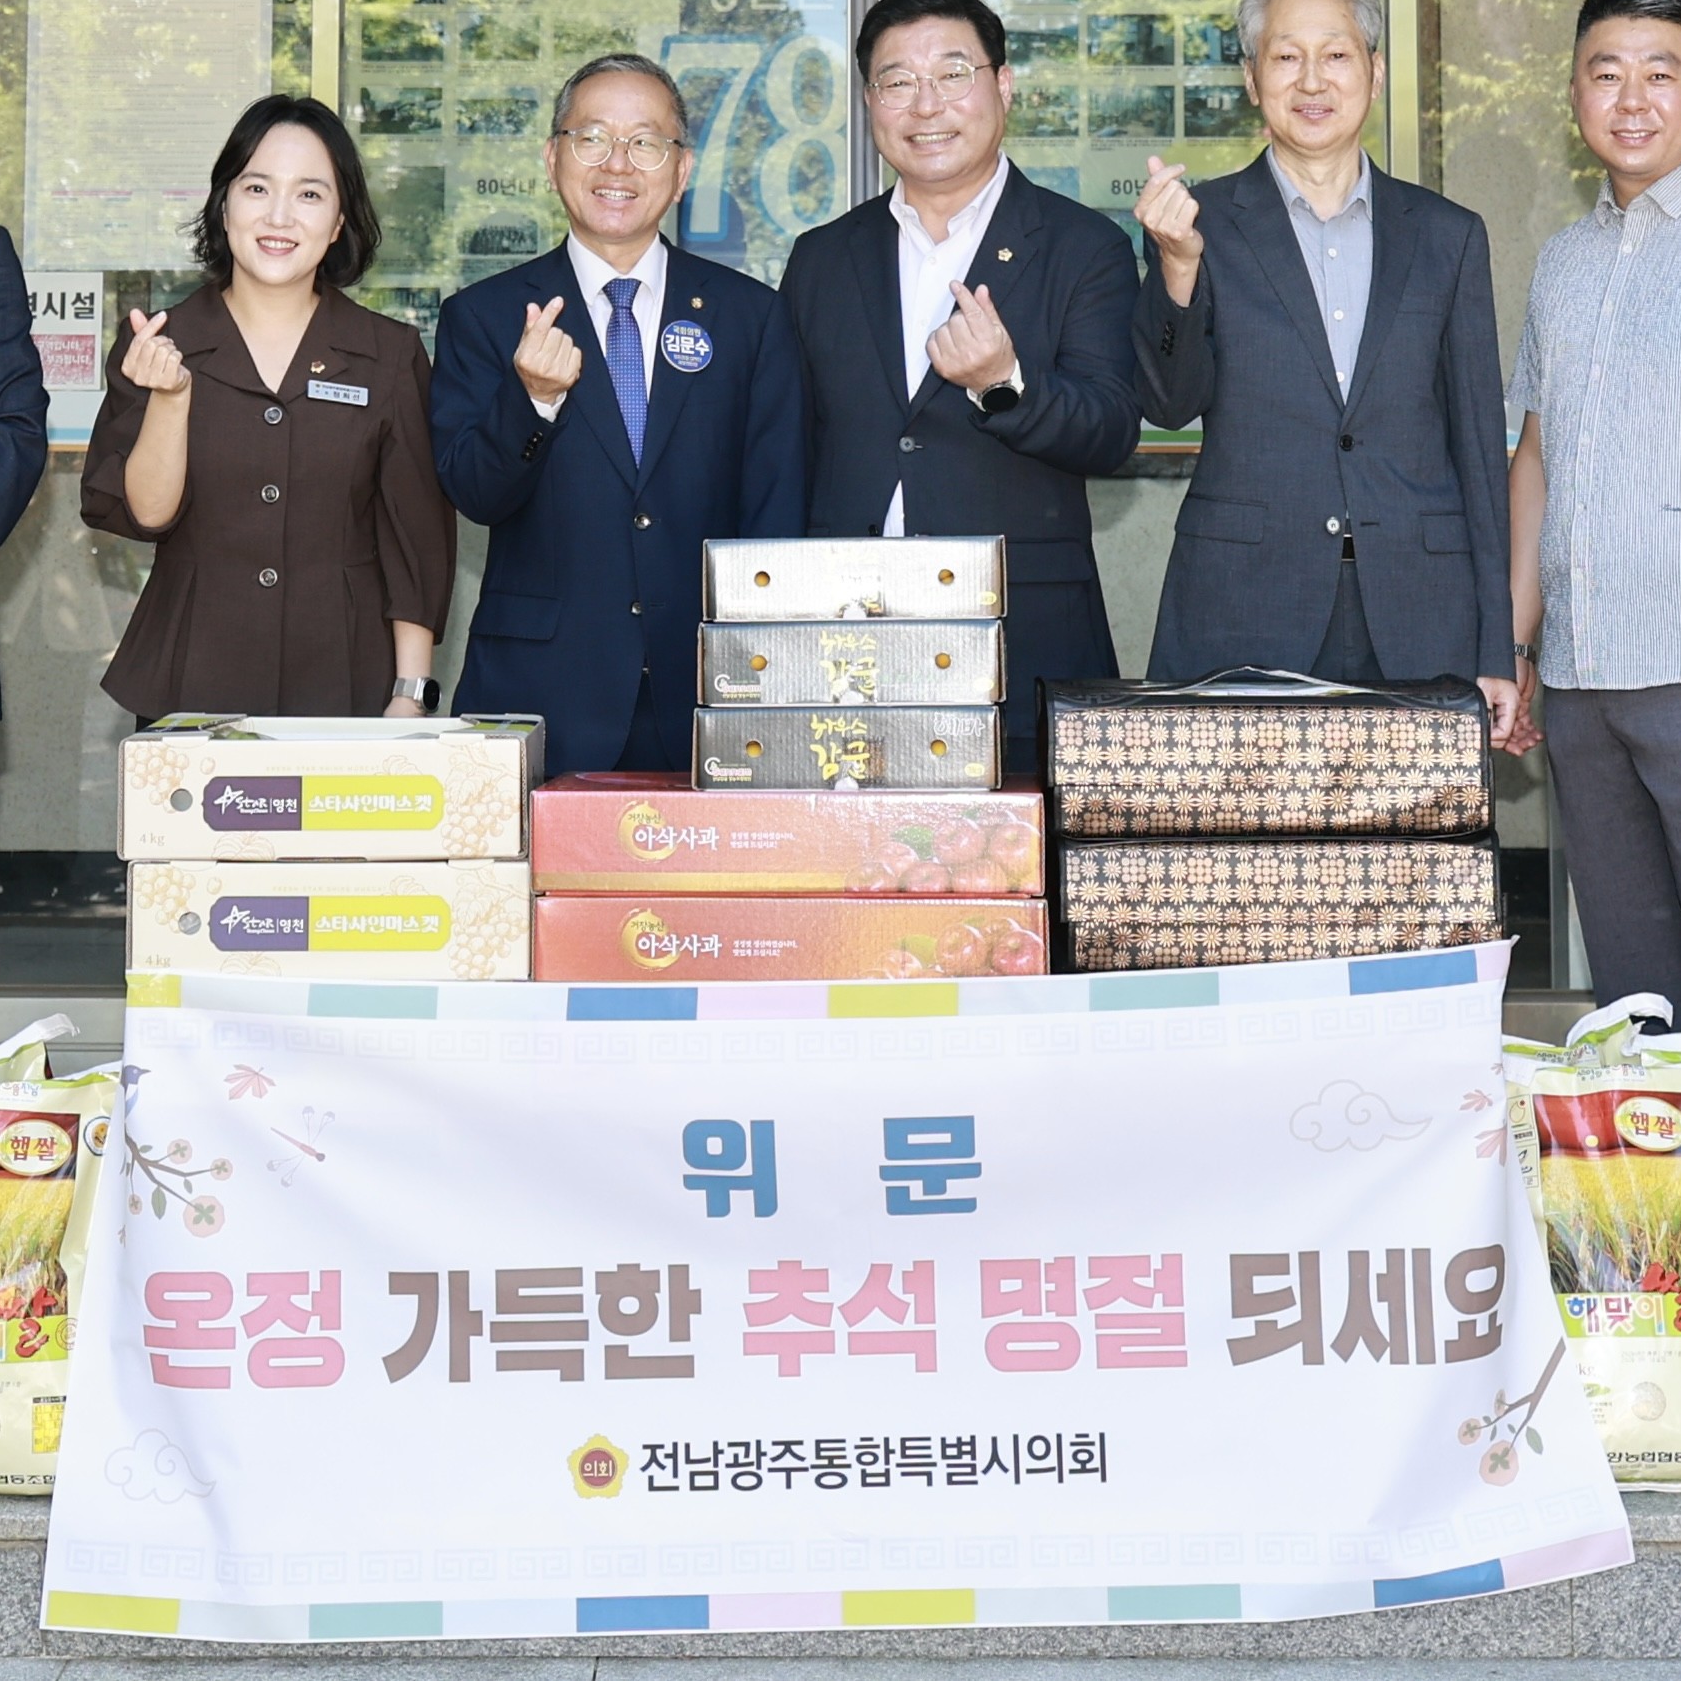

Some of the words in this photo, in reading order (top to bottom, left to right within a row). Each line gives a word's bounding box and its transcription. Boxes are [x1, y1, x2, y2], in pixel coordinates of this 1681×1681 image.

[659, 30, 849, 241] 78
[665, 334, 710, 356] 김문수
[272, 798, 297, 814] 영천
[139, 833, 147, 844] 4
[149, 831, 165, 846] kg
[635, 826, 719, 850] 아삭사과
[279, 918, 304, 934] 영천
[638, 933, 722, 958] 아삭사과
[145, 955, 153, 965] 4
[155, 953, 171, 968] kg
[1630, 1111, 1676, 1140] 햅쌀
[10, 1135, 58, 1162] 햅쌀
[682, 1117, 777, 1220] 위
[879, 1114, 983, 1217] 문
[144, 1267, 346, 1390] 온정
[381, 1263, 703, 1384] 가득한
[742, 1260, 939, 1378] 추석
[979, 1252, 1188, 1371] 명절
[1225, 1242, 1507, 1369] 되세요
[1565, 1296, 1665, 1335] 해맞이
[582, 1460, 614, 1479] 의회
[639, 1431, 1109, 1493] 전남광주통합특별시의회
